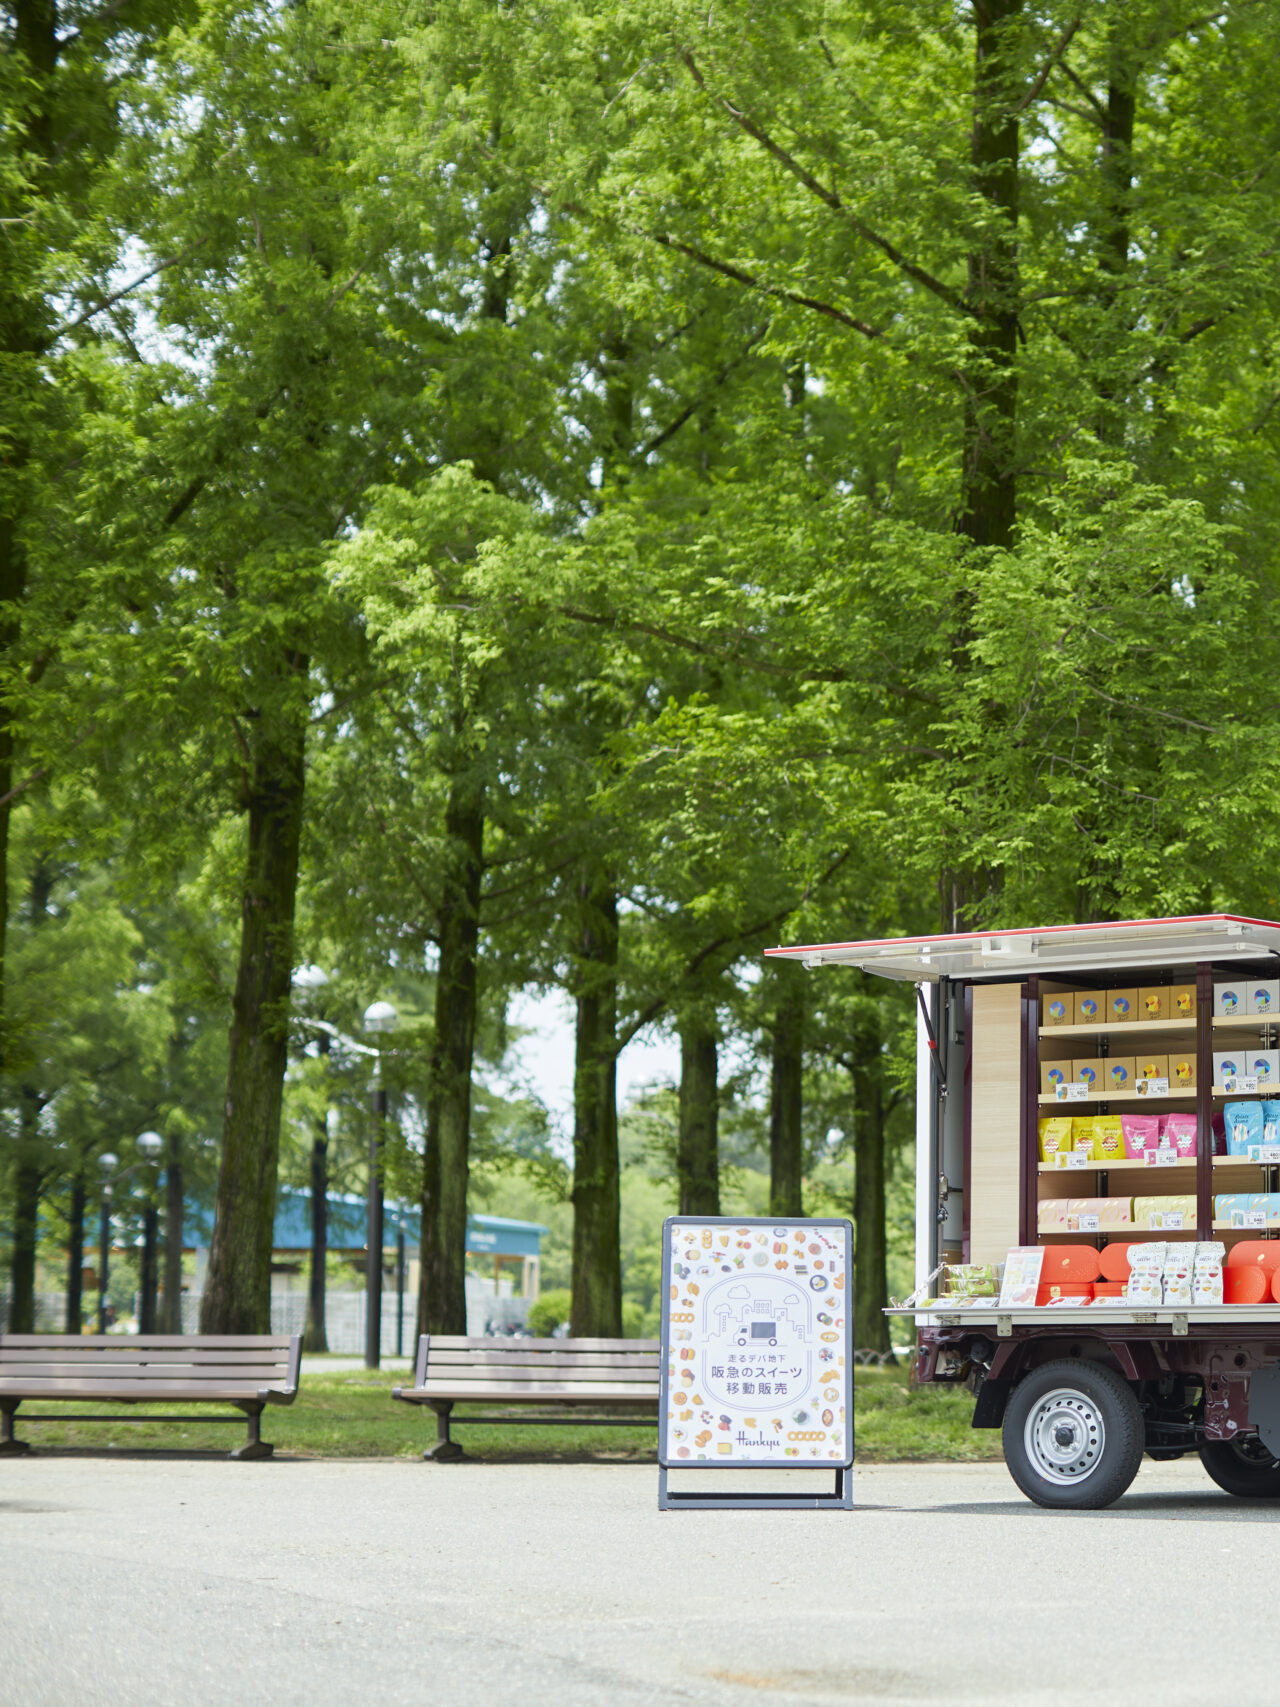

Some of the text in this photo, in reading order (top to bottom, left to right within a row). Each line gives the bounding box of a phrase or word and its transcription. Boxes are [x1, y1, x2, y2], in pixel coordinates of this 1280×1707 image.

[727, 1354, 787, 1363] 走るデパ地下
[711, 1366, 802, 1379] 阪急のスイーツ
[726, 1382, 788, 1395] 移動販売
[735, 1430, 780, 1452] Hankyu
